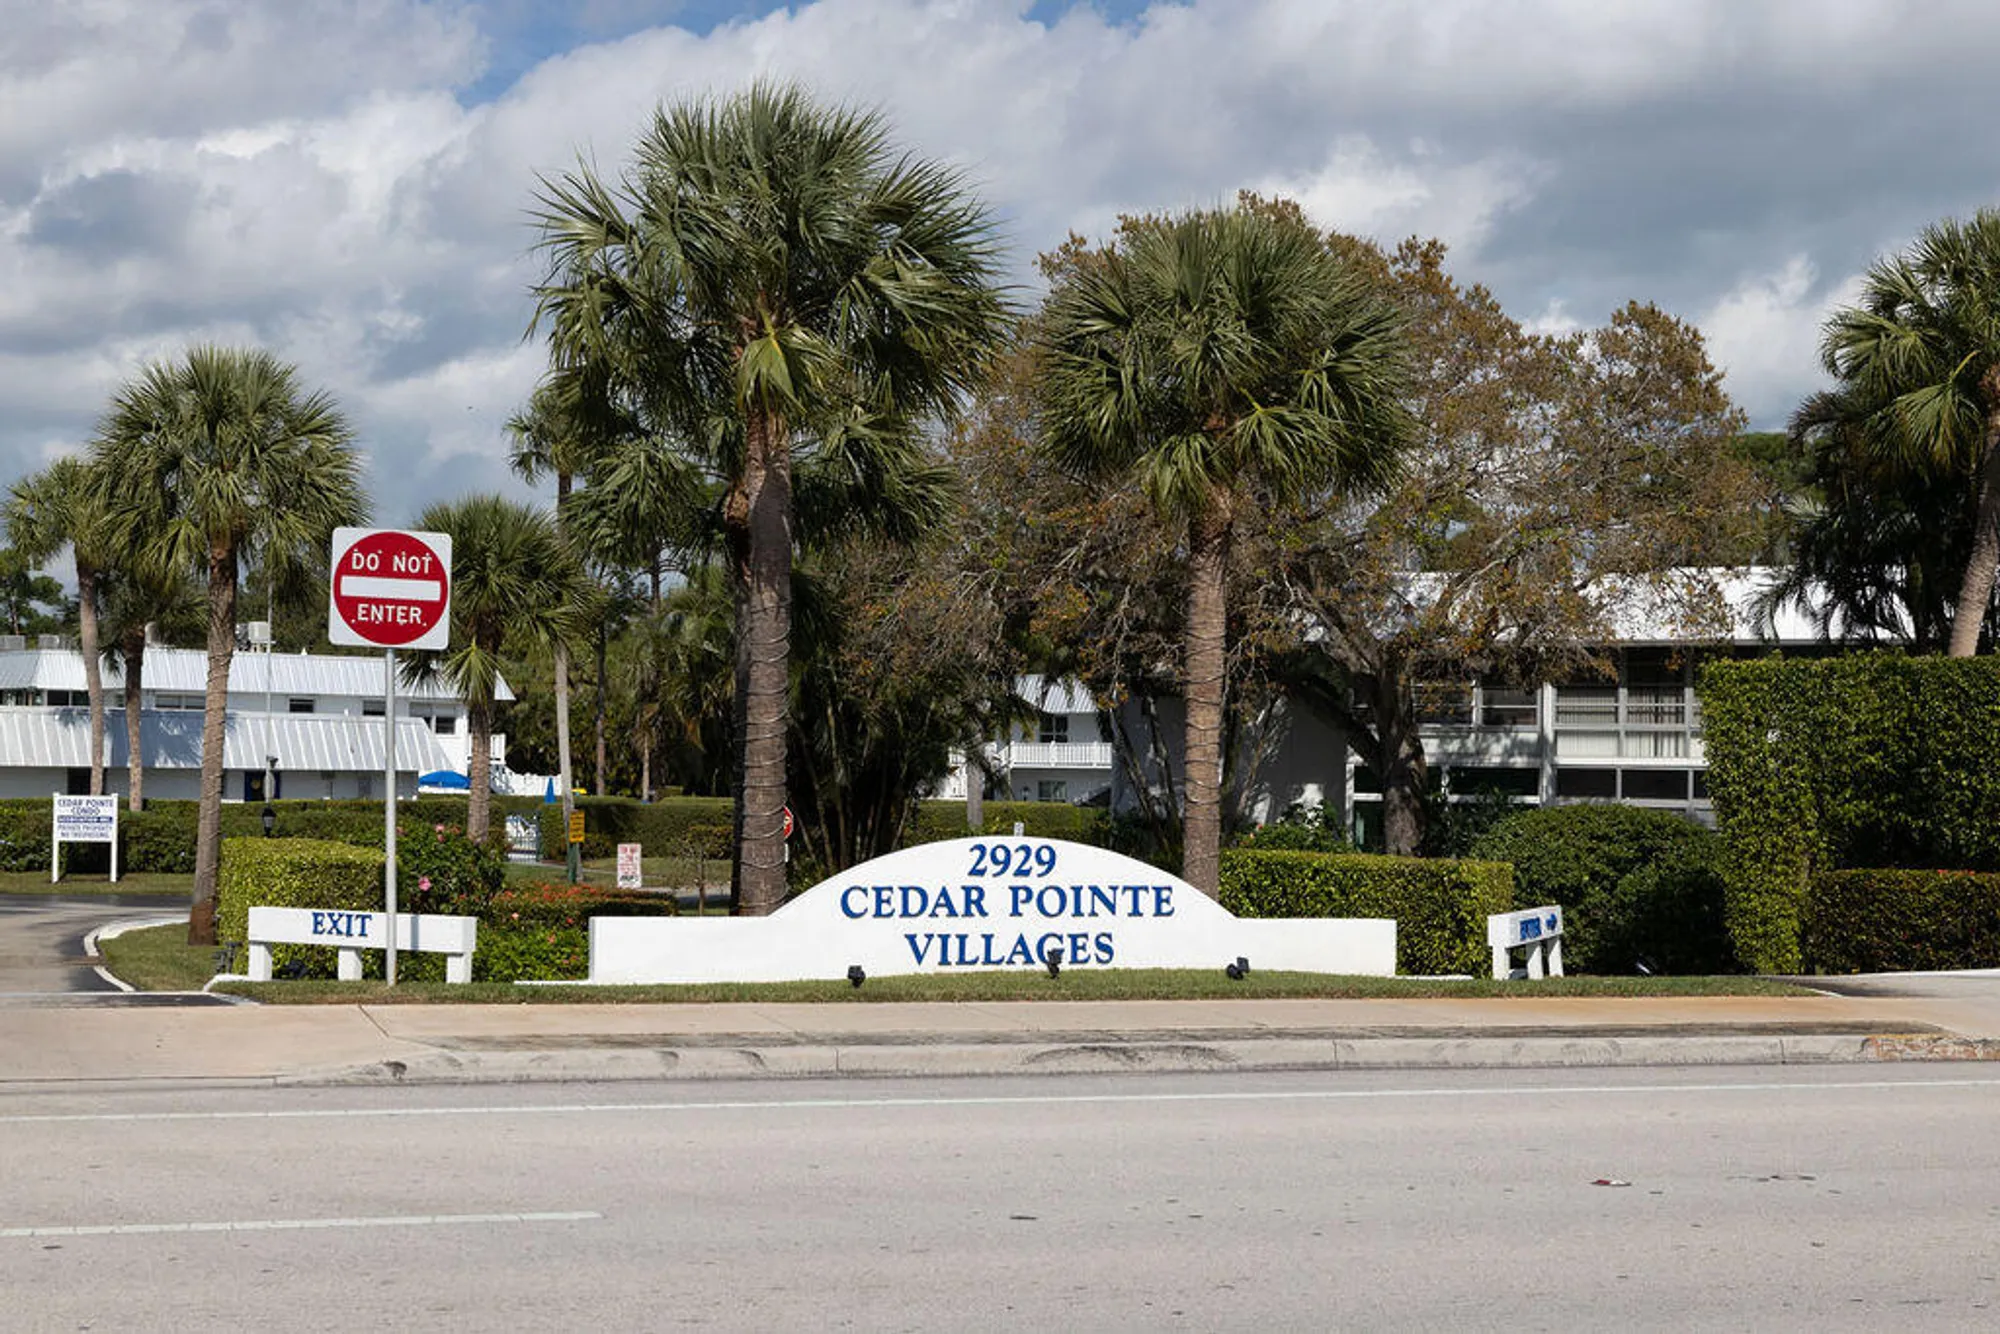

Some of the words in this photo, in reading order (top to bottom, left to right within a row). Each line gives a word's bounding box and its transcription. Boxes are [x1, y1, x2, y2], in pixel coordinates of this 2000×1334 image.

[351, 552, 380, 572] DO
[392, 554, 433, 574] NOT
[357, 603, 422, 625] ENTER
[58, 799, 83, 807] CEDAR
[967, 843, 1057, 877] 2929
[840, 885, 989, 919] CEDAR
[1008, 885, 1175, 917] POINTE
[312, 912, 373, 937] EXIT
[904, 932, 1115, 966] VILLAGES
